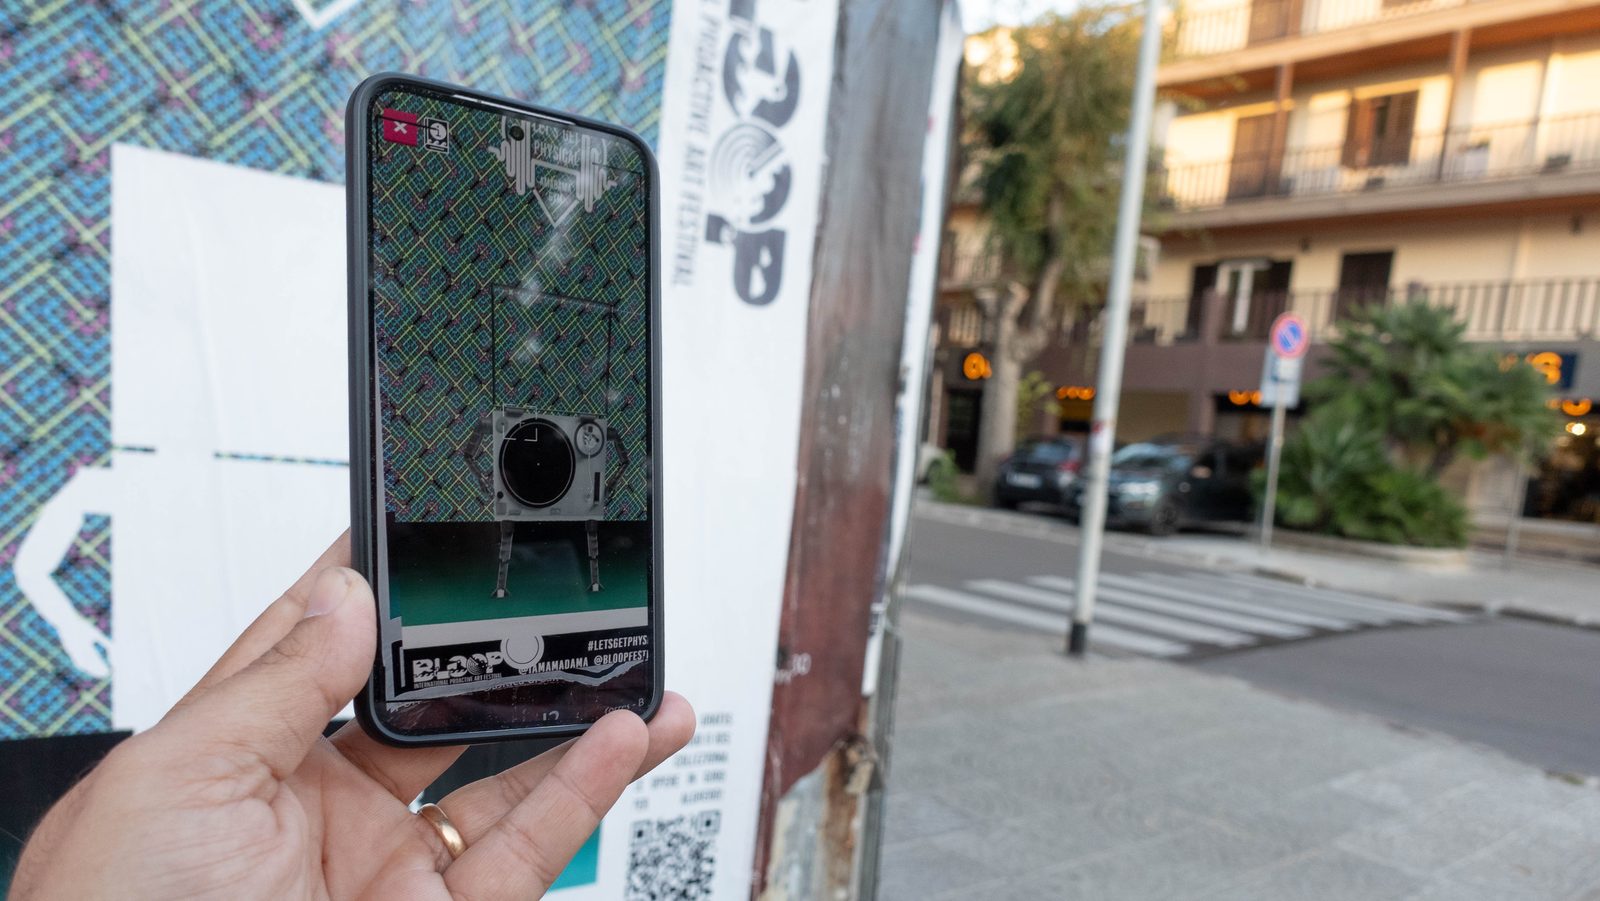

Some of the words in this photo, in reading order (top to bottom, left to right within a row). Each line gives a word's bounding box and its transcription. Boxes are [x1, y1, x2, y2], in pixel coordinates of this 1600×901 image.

[413, 650, 504, 682] BLOOP
[413, 679, 449, 689] INTERNATIONAL
[449, 676, 473, 685] PROACTIVE
